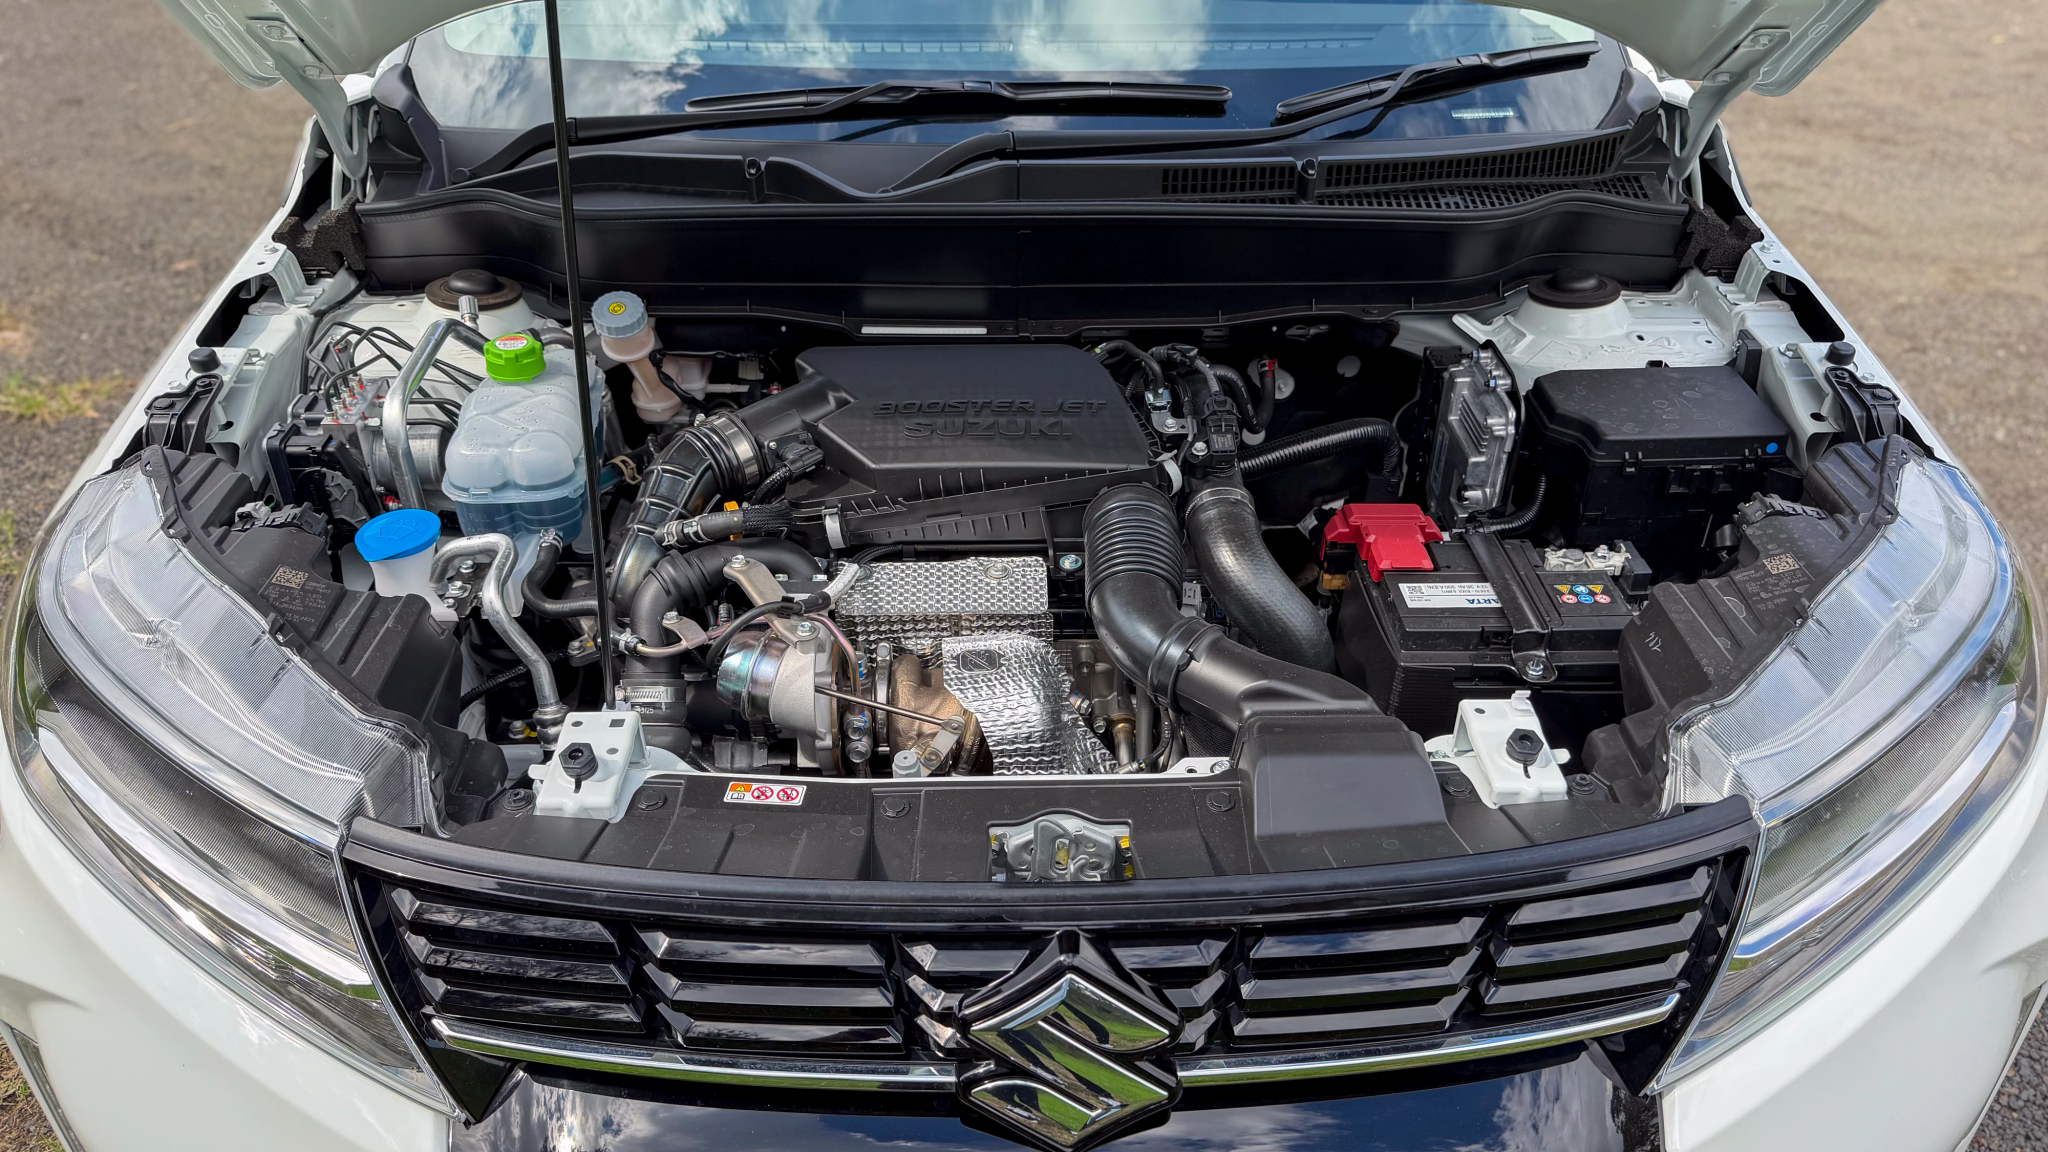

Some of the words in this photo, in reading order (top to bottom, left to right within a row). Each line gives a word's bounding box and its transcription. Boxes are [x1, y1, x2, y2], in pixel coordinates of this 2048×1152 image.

[874, 399, 1035, 416] BOOSTER
[1040, 399, 1107, 414] JET
[903, 418, 1073, 439] SUZUKI
[469, 513, 491, 521] FULL
